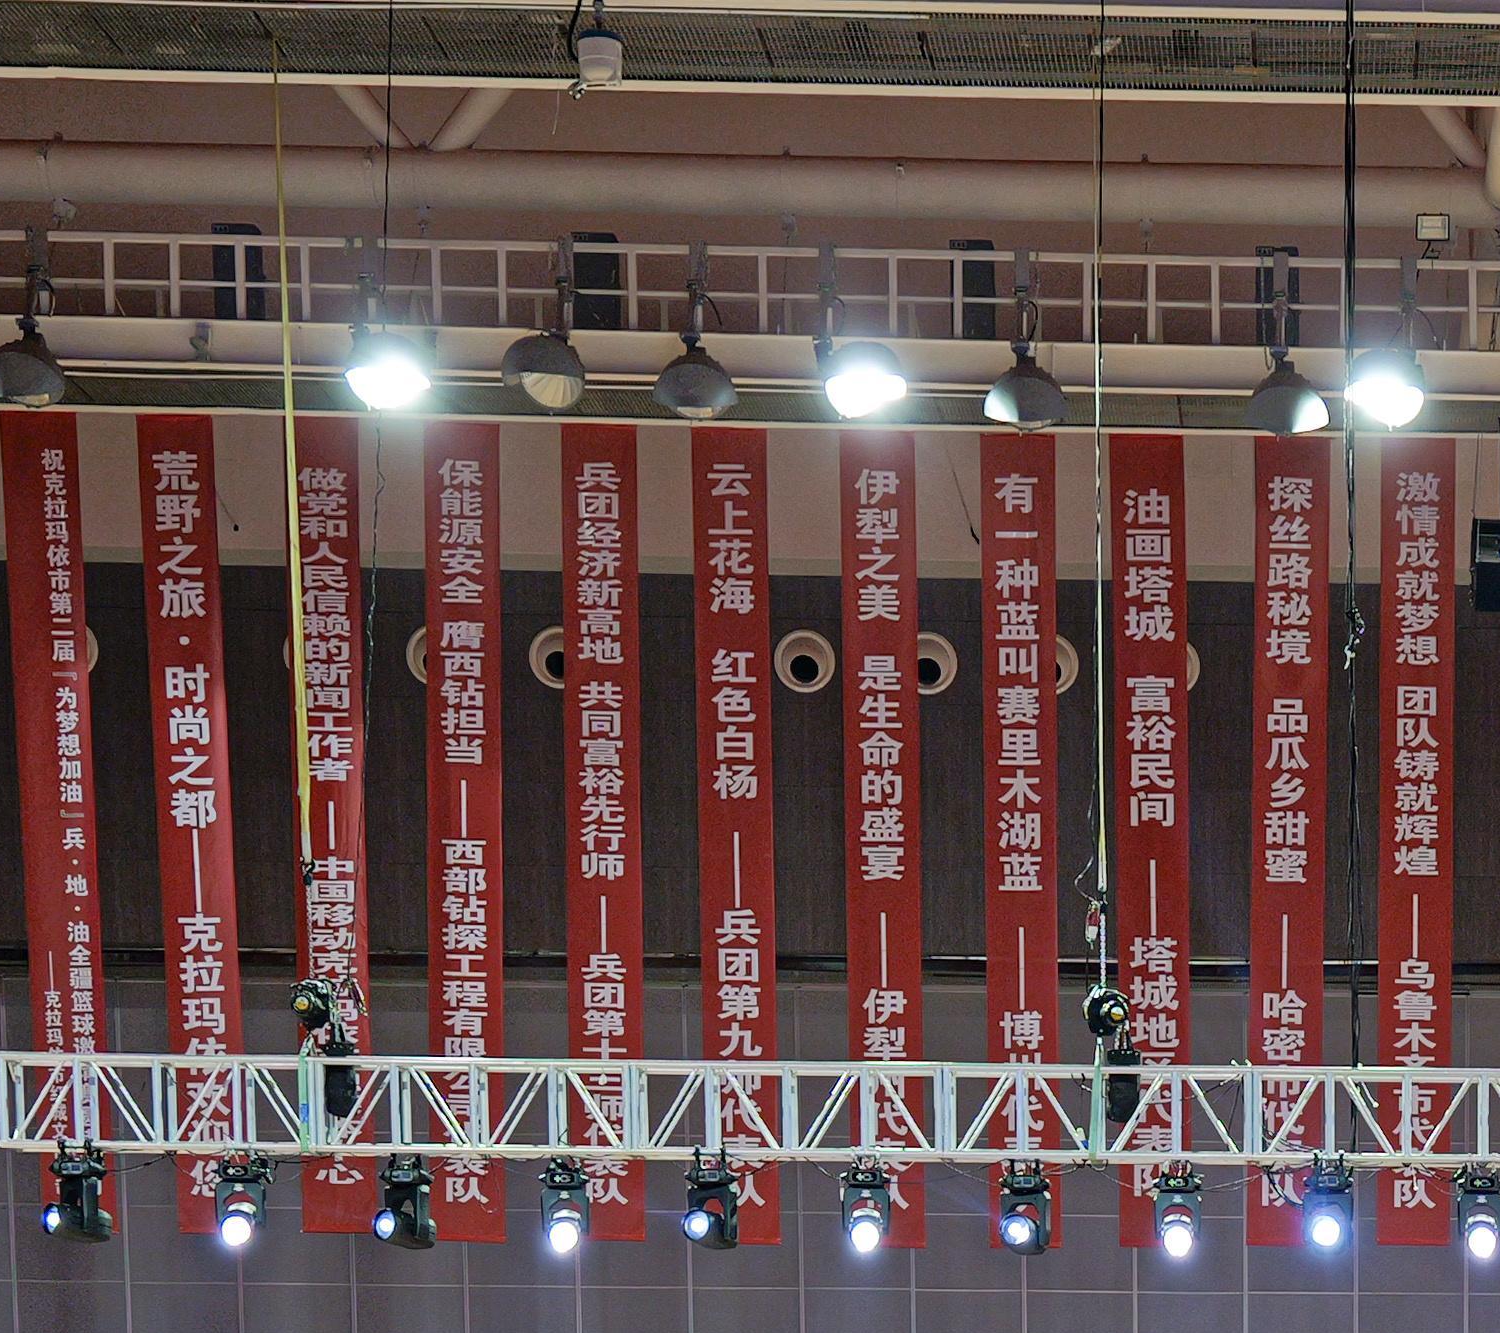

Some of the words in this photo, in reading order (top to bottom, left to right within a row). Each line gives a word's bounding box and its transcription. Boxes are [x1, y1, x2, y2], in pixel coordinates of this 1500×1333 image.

[439, 459, 484, 604] 保能源安全
[574, 462, 624, 664] 兵团经济新高地
[707, 463, 754, 614] 云上花海
[855, 469, 901, 621] 伊犁之美
[1123, 489, 1175, 642] 油画塔城
[1266, 477, 1313, 664] 探丝路秘境
[1395, 472, 1440, 666] 激情成就梦想
[711, 649, 757, 799] 红色白杨
[857, 655, 905, 881] 是生命的盛宴
[994, 474, 1043, 891] 有一种蓝叫赛里木湖蓝
[1126, 676, 1175, 827] 富裕民间
[579, 681, 626, 880] 共同富裕先行师
[1264, 699, 1309, 883] 品瓜乡甜蜜
[1394, 685, 1440, 876] 团队铸就辉煌
